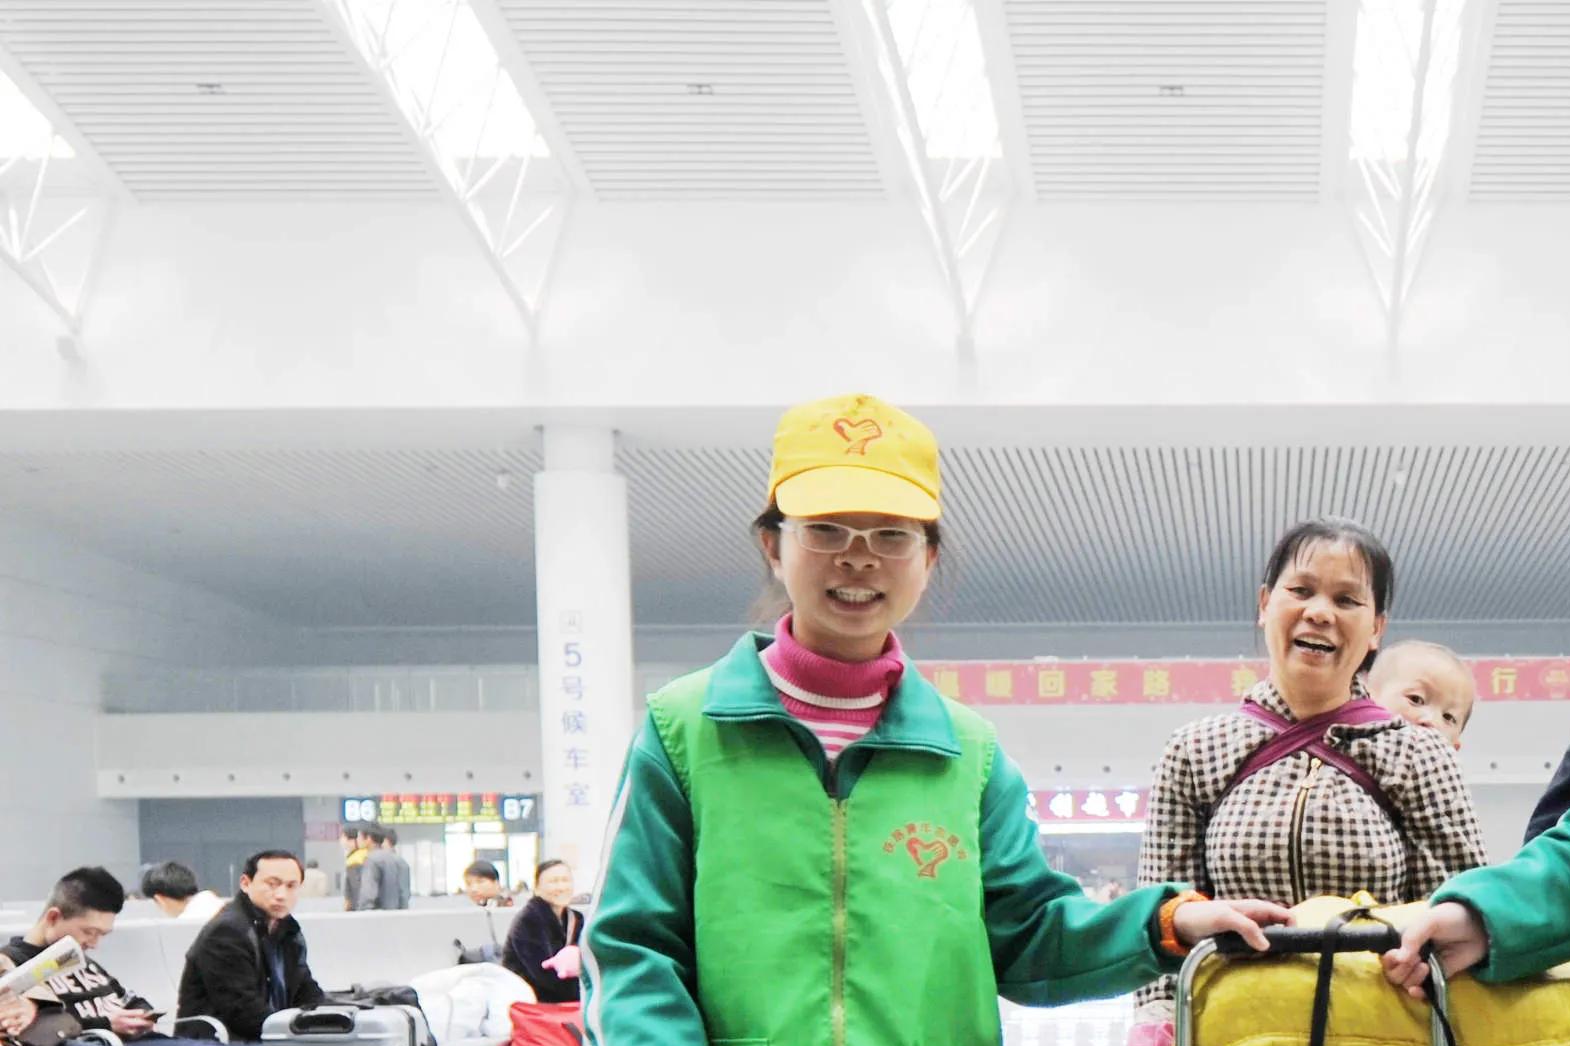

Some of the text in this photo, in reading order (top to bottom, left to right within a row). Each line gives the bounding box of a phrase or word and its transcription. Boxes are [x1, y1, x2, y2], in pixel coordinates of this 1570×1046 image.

[561, 642, 590, 806] 5号候车室
[503, 798, 534, 821] B7
